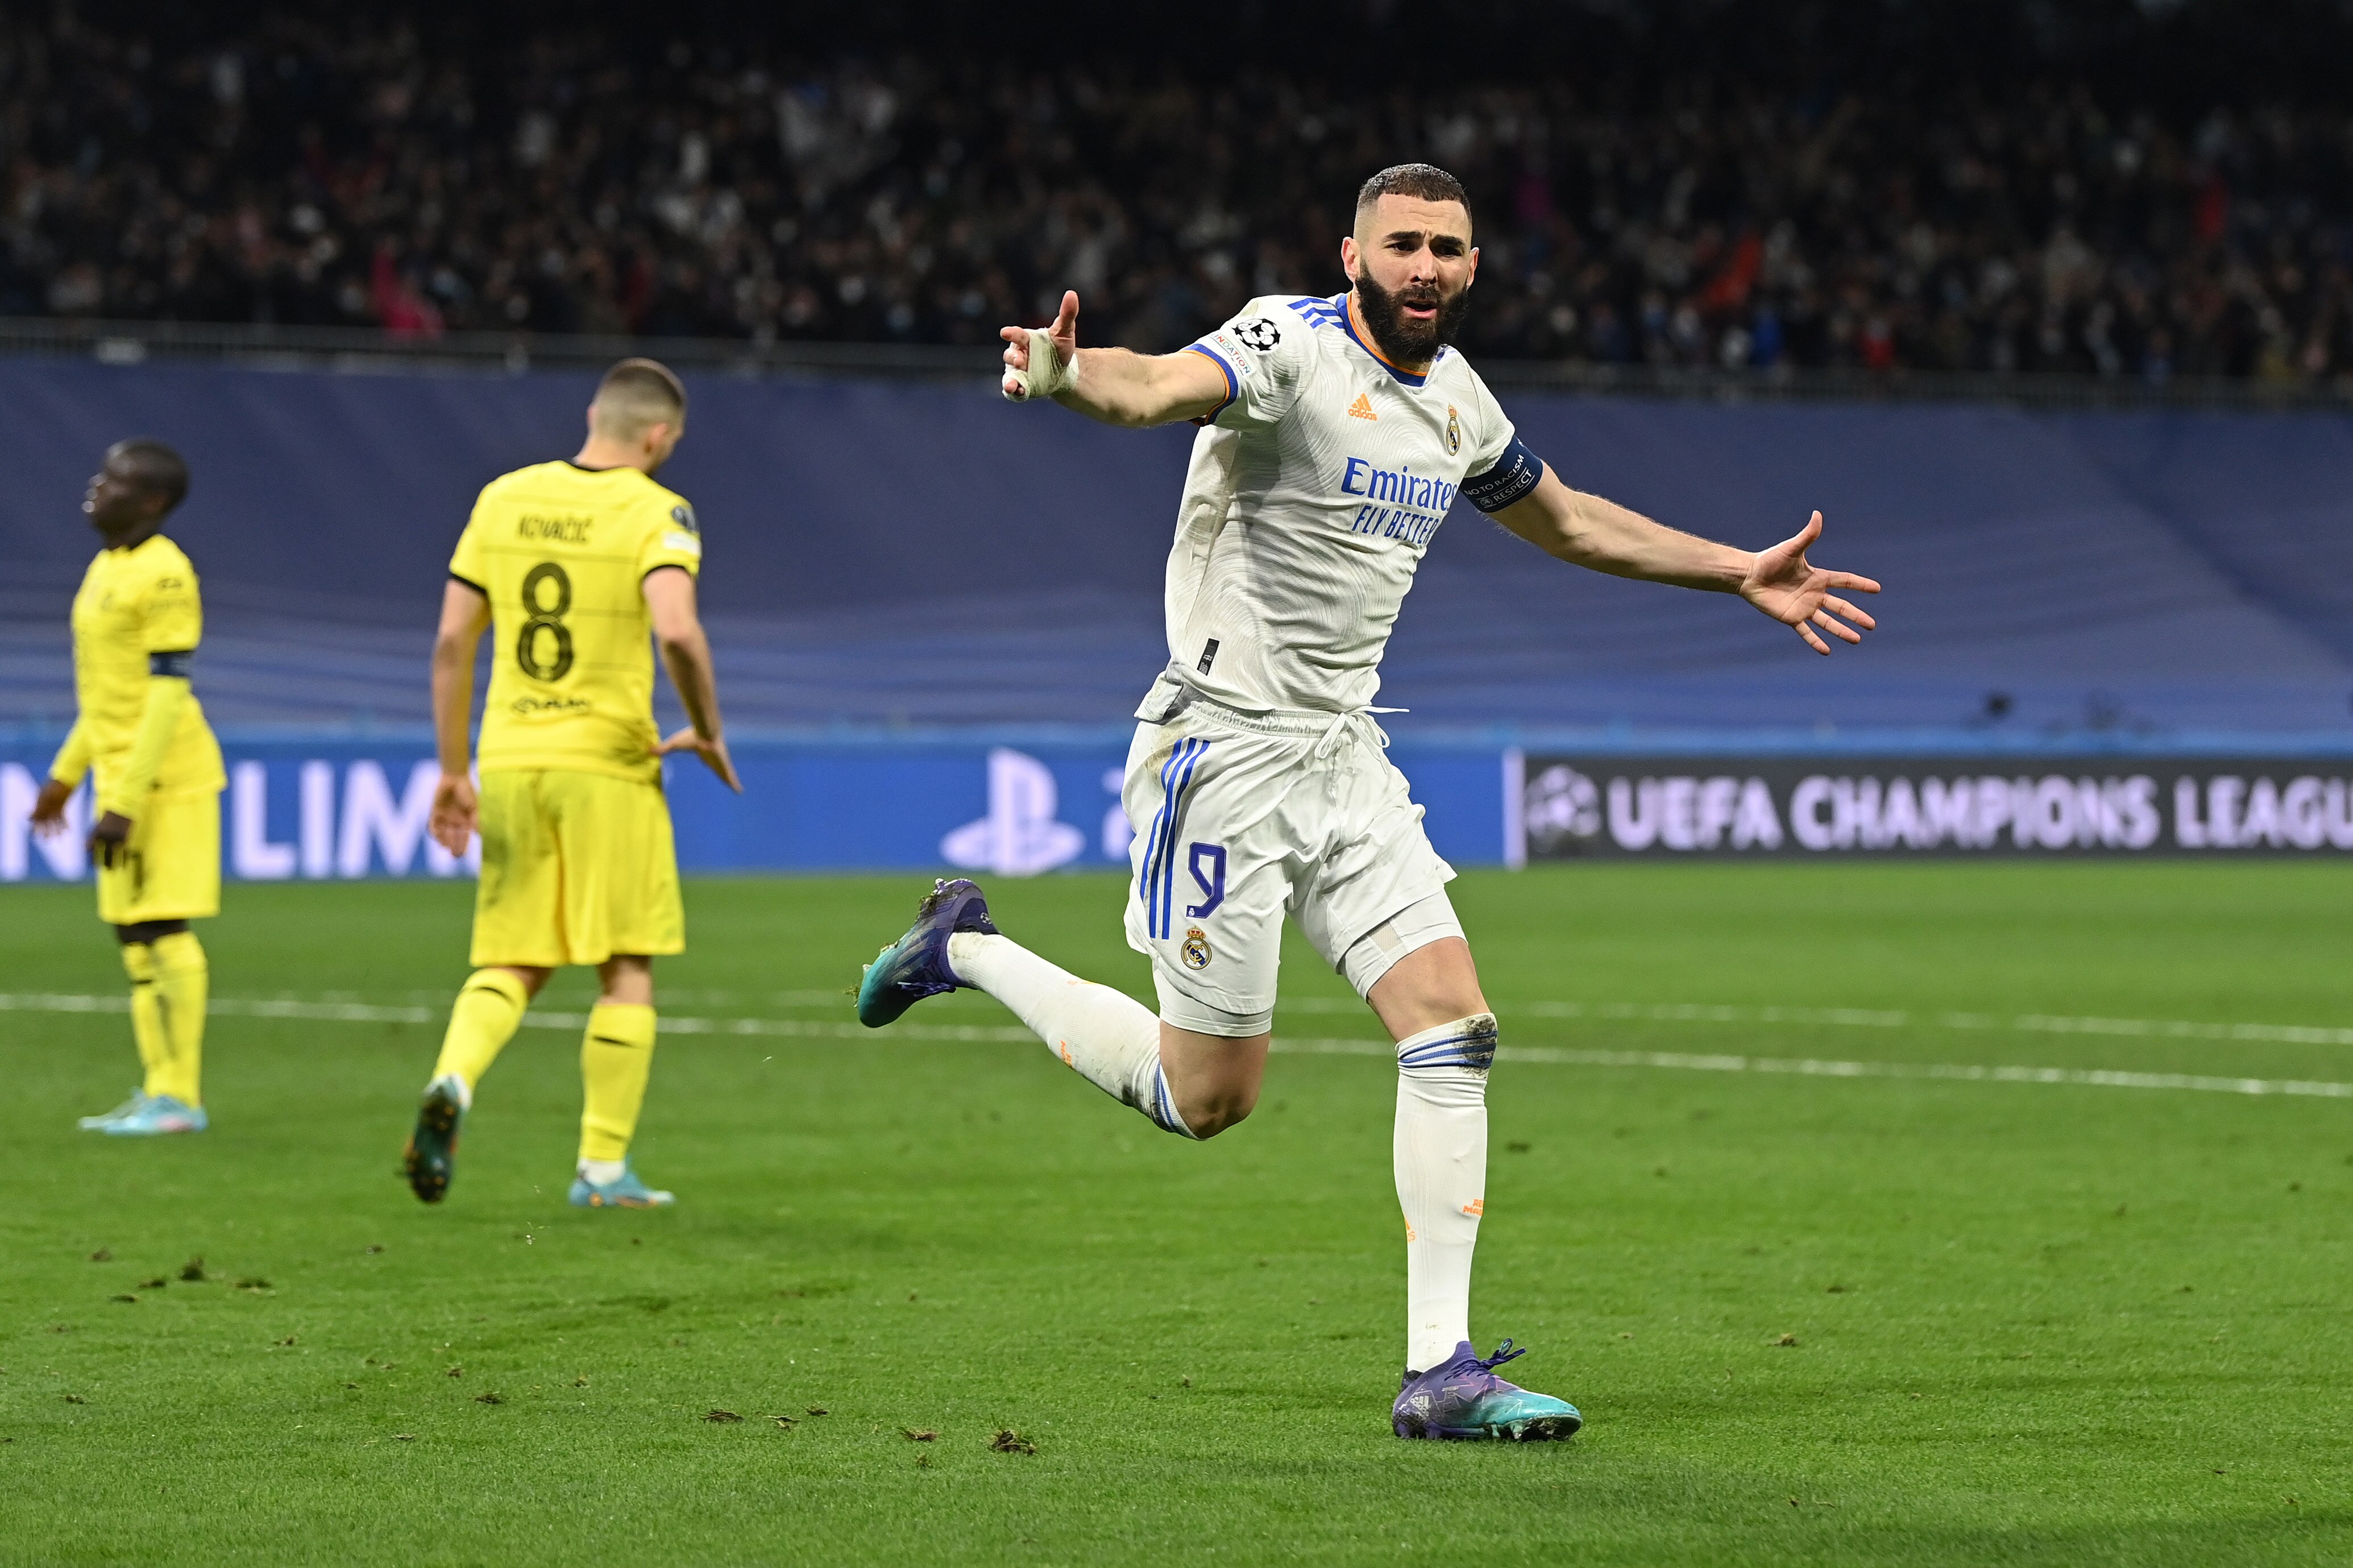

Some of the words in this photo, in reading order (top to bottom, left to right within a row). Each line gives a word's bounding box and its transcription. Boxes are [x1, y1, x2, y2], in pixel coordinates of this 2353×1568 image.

[1348, 409, 1377, 421] adidas
[1341, 456, 1458, 511] Emirates
[1493, 469, 1532, 502] RESPECT
[1494, 454, 1525, 486] RACISM
[1351, 505, 1390, 535] FLY
[1384, 510, 1440, 545] BETTER
[517, 562, 574, 682] 8
[232, 760, 481, 880] LIM
[1607, 775, 1783, 850] UEFA
[1790, 774, 2159, 850] CHAMPIONS
[2173, 775, 2353, 850] LEAGU
[1186, 842, 1227, 918] 9
